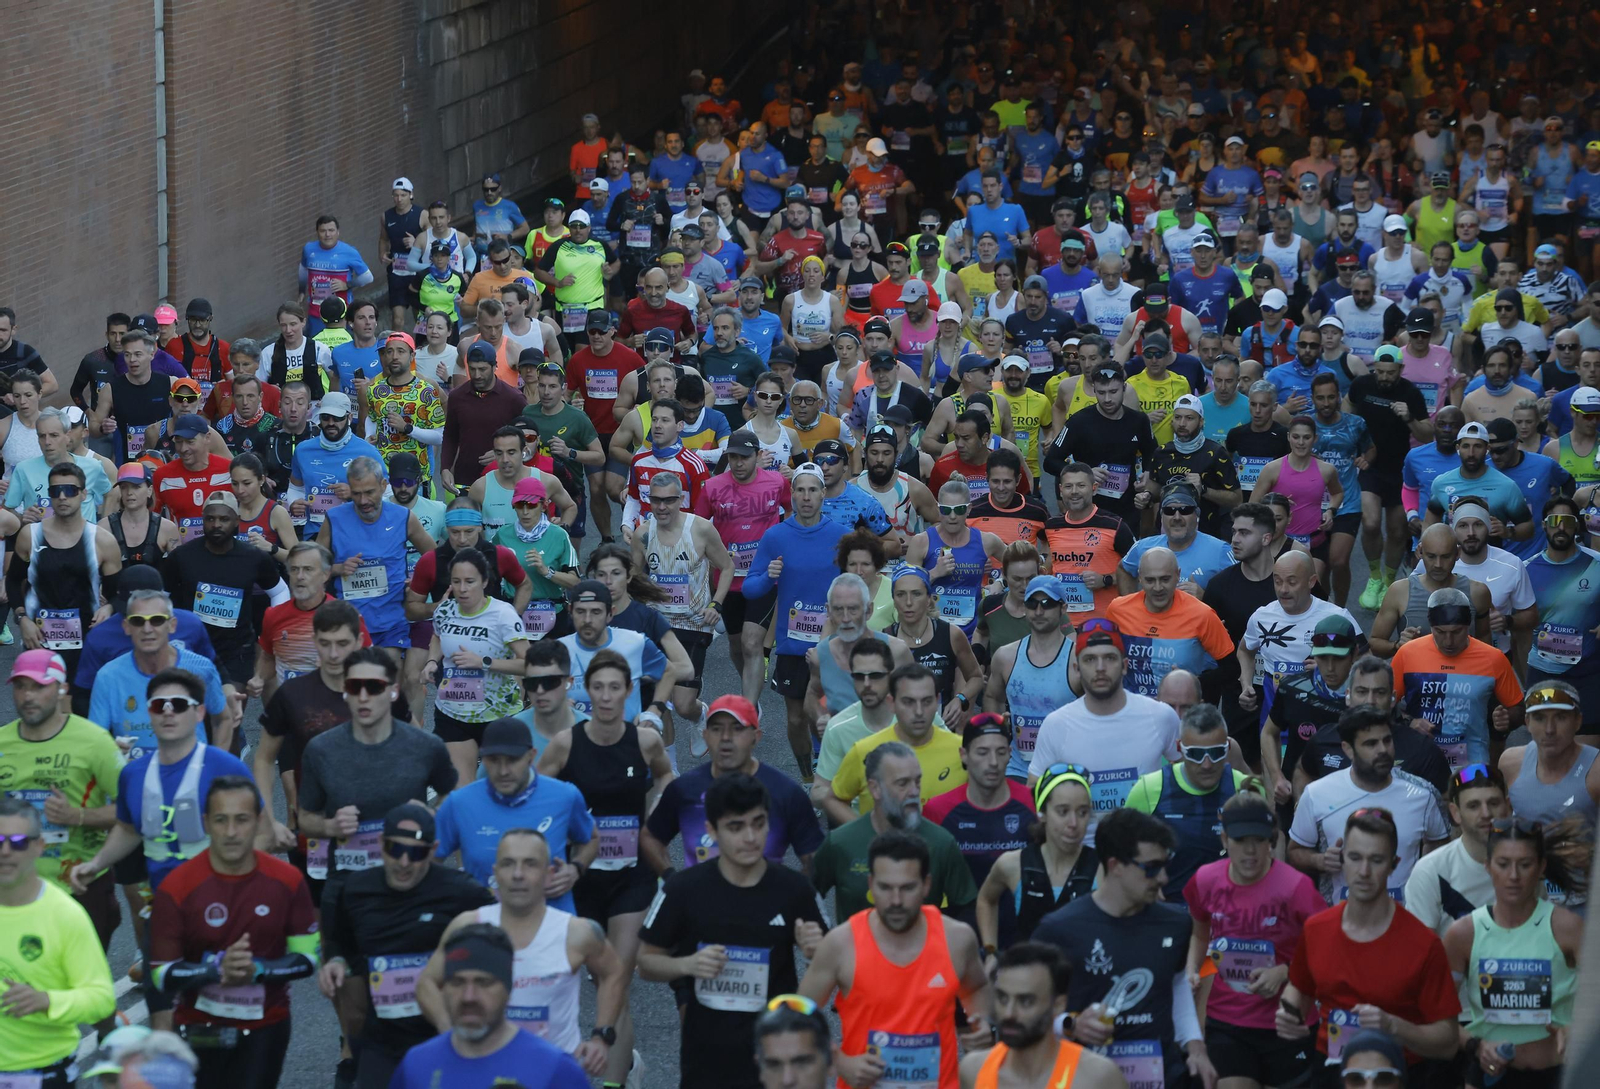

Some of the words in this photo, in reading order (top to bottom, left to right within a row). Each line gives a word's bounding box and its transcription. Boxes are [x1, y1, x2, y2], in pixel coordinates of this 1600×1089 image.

[1011, 416, 1040, 426] EROS
[1239, 474, 1256, 482] ARGA
[1104, 481, 1121, 490] TRIS
[350, 577, 379, 590] MARTÍ
[212, 586, 239, 598] ZURICH
[804, 604, 828, 612] ZURICH
[942, 607, 962, 617] GAIL
[525, 622, 545, 632] MIMI
[795, 621, 823, 633] RUBEN
[44, 630, 81, 640] ARISCAL
[1127, 643, 1154, 656] ESTO
[1157, 645, 1176, 659] NO
[453, 669, 479, 677] ZURICH
[1421, 681, 1447, 695] ESTO
[1453, 681, 1471, 695] NO
[444, 689, 477, 701] AINARA
[1420, 697, 1431, 708] SE
[1434, 697, 1471, 711] ACABA
[1098, 771, 1131, 781] ZURICH
[357, 823, 385, 832] ZURIC
[599, 819, 633, 829] ZURICH
[597, 845, 625, 858] NNA
[1231, 942, 1267, 952] ZURICH
[1501, 962, 1543, 973] ZURICH
[699, 979, 750, 996] ALVARO
[754, 983, 762, 996] E
[1503, 981, 1526, 992] 3263
[1488, 993, 1542, 1009] MARINE
[507, 1009, 542, 1020] URICH
[892, 1035, 934, 1047] ZURICH
[1112, 1044, 1154, 1055] ZURICH
[883, 1066, 930, 1082] ARLOS
